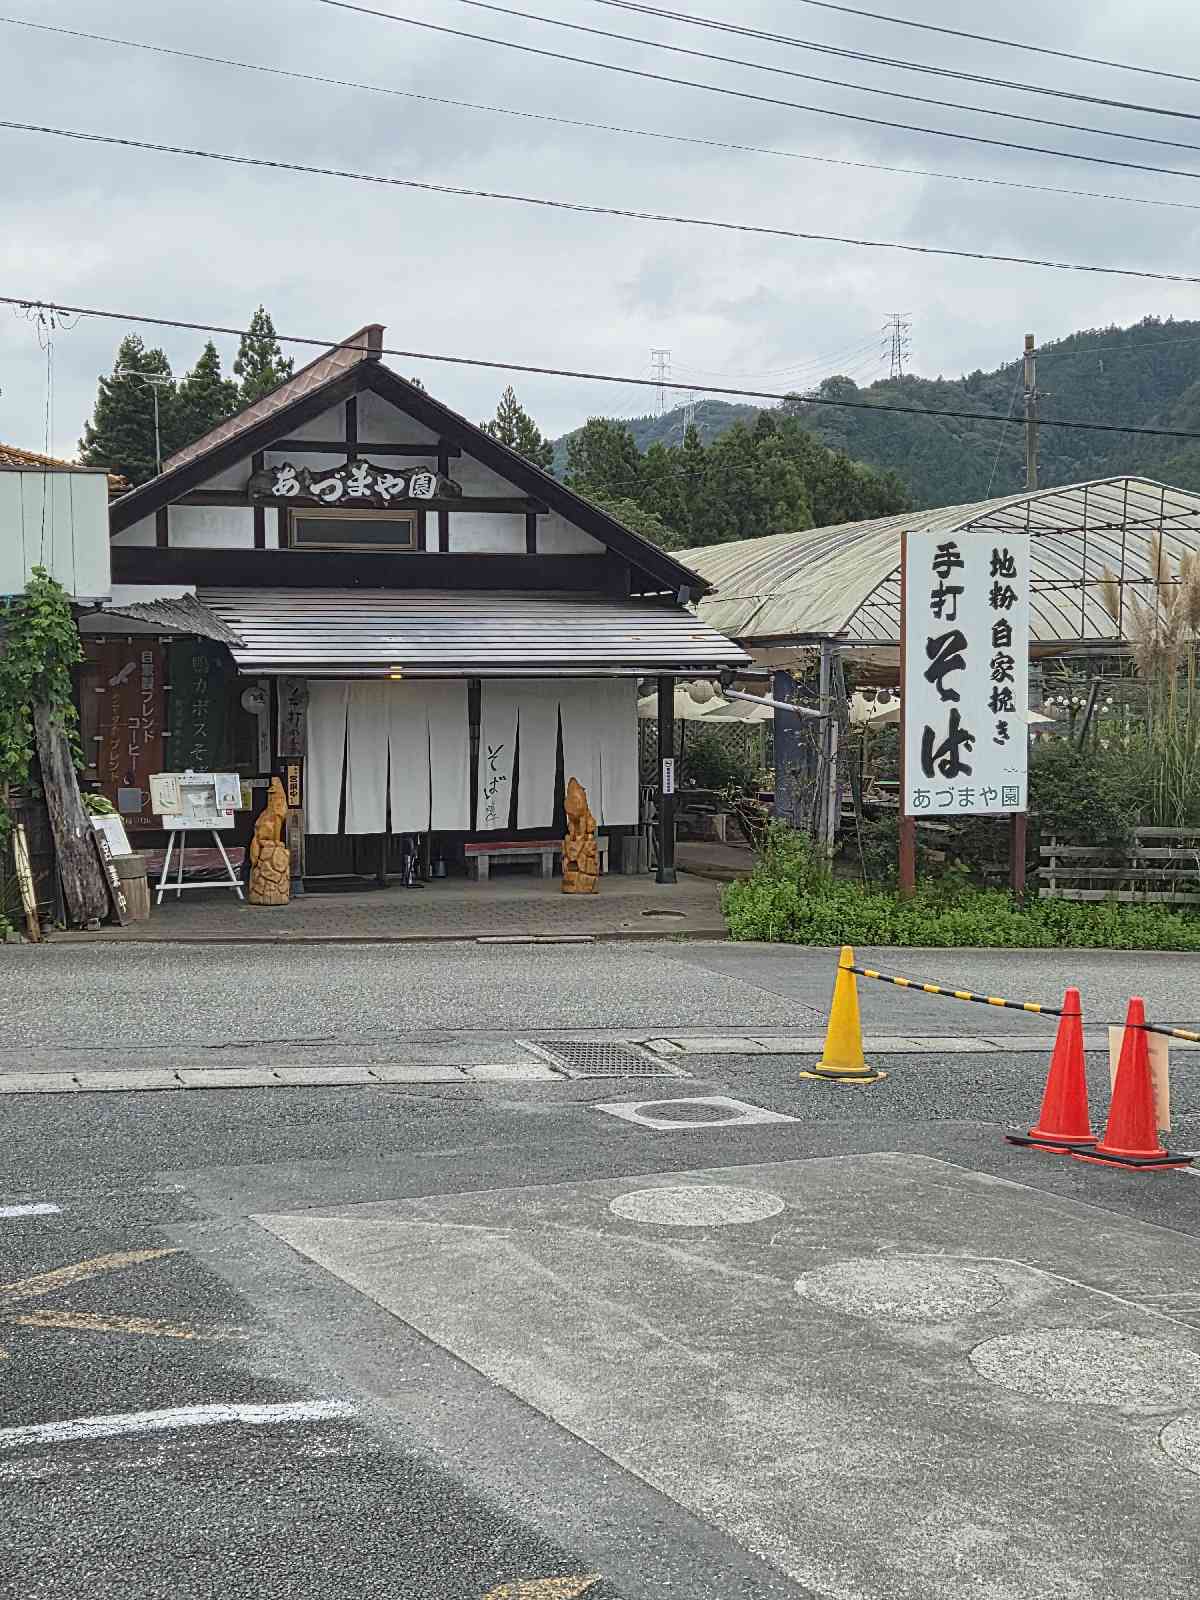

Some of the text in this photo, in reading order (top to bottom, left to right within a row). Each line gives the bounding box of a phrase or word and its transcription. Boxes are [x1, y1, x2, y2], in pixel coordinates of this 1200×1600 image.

[272, 463, 437, 504] あづまや園
[921, 541, 975, 779] 手打そば
[988, 547, 1018, 746] 地粉自家挽き
[128, 717, 140, 771] コーヒー
[913, 785, 1020, 808] あづまや園
